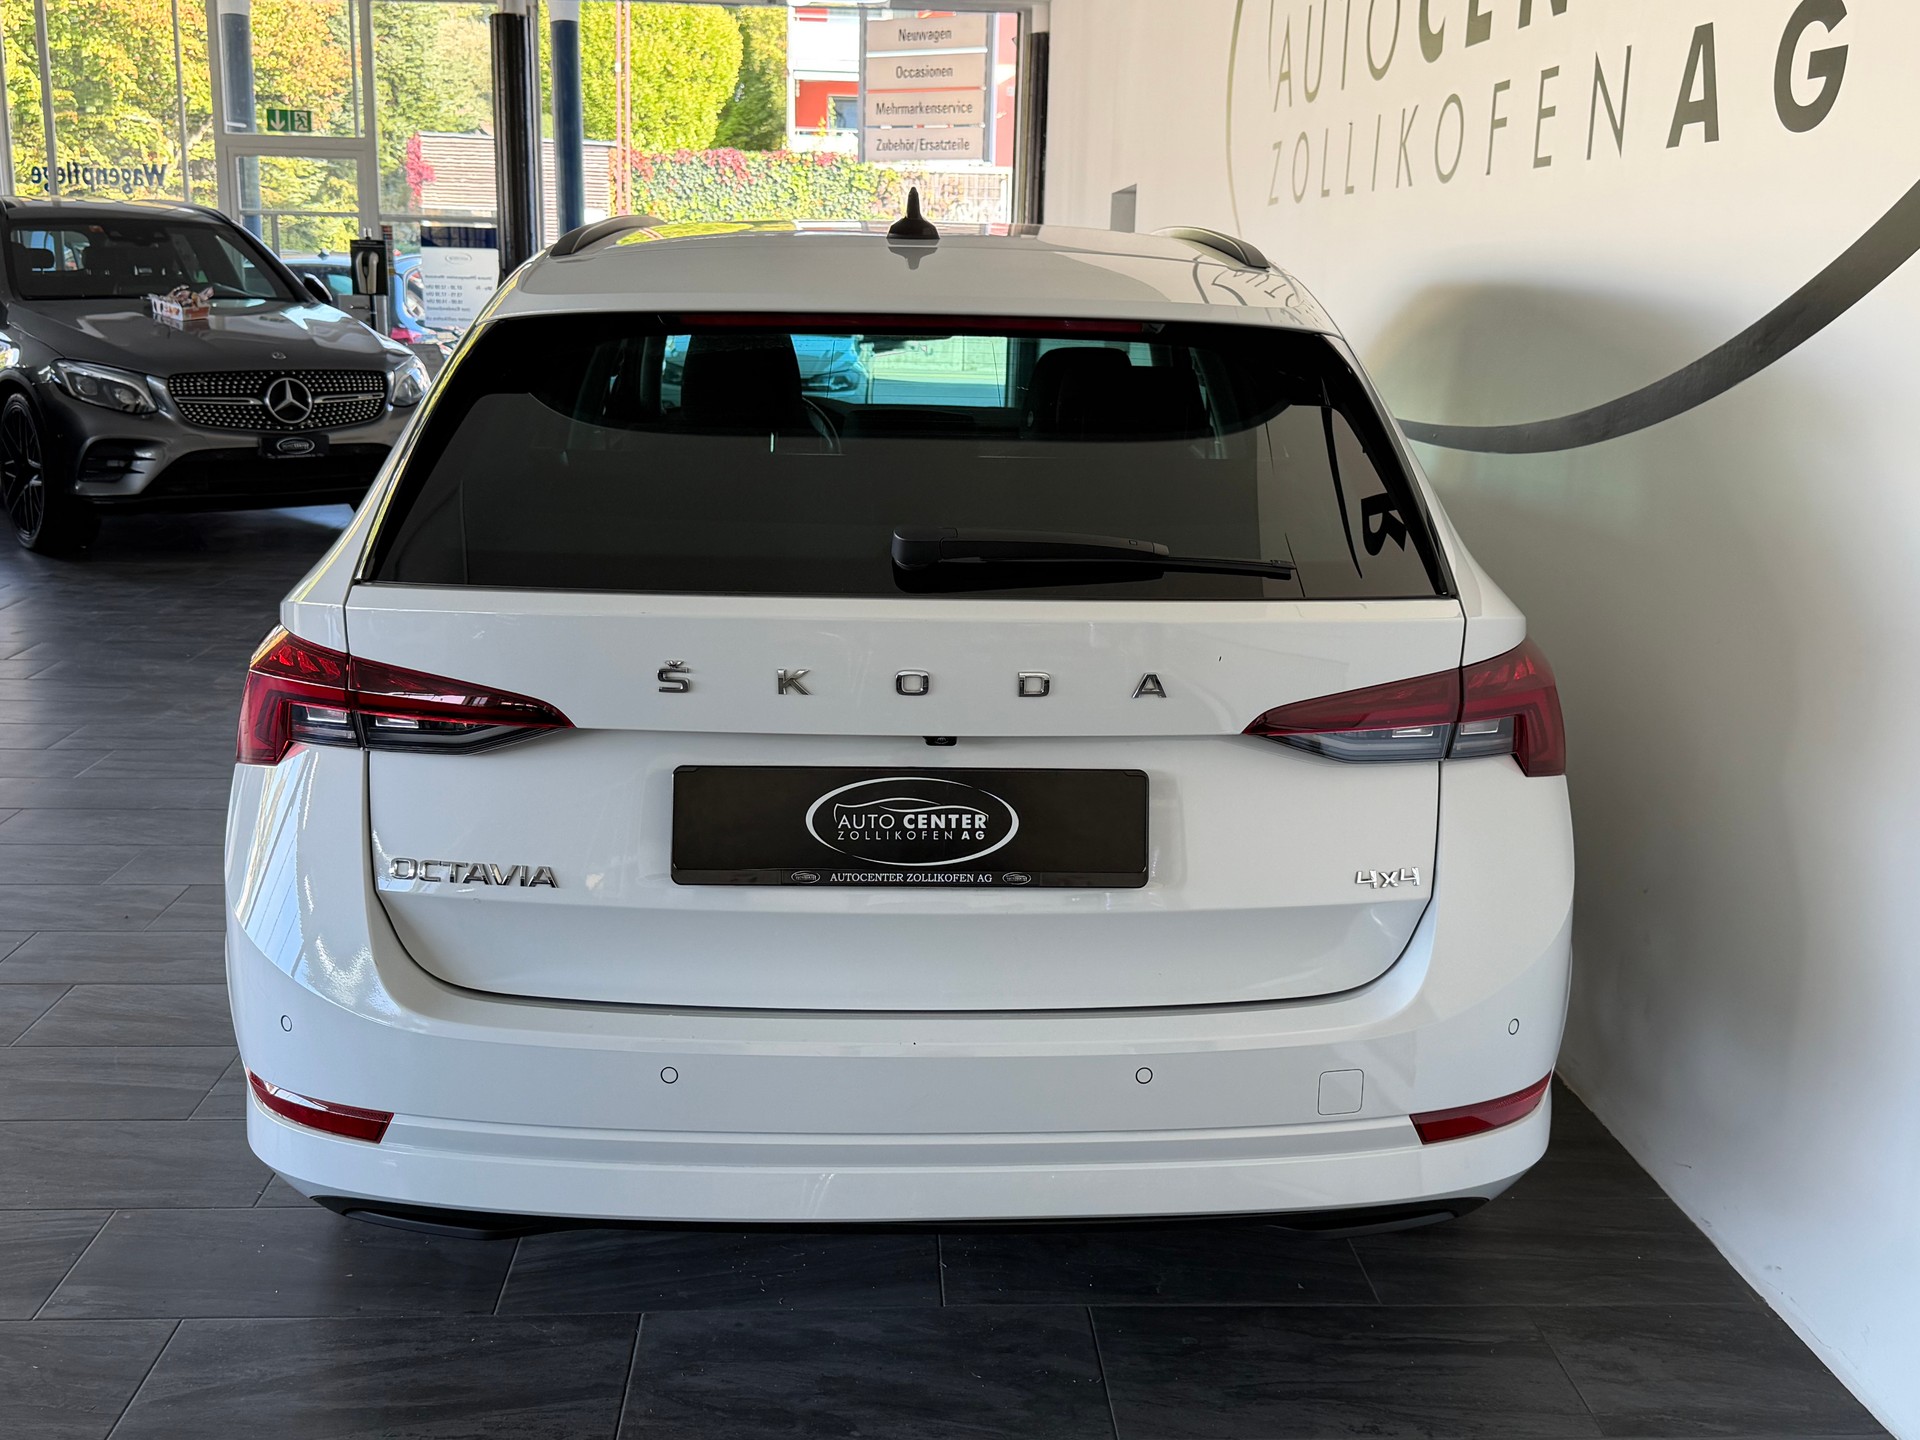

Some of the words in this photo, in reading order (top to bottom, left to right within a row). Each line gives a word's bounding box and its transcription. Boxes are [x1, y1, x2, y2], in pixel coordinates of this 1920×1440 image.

[898, 28, 952, 43] Neuwagen
[1273, 0, 1400, 112] AUTO
[895, 65, 953, 79] Occasionen
[876, 101, 973, 115] Mehrmarkenservice
[1267, 44, 1633, 207] ZOLLIKOFEN
[1666, 0, 1849, 148] AG
[876, 137, 970, 152] Zubehör/Ersatzteile
[657, 660, 1168, 698] ŠKODA
[838, 814, 895, 829] AUTO
[903, 814, 987, 829] CENTER
[837, 830, 953, 840] ZOLLIKOFEN
[961, 830, 985, 840] AG
[389, 857, 559, 888] OCTAVIA
[830, 873, 904, 882] AUTOCENTER
[906, 873, 976, 882] ZOLLIKOFEN
[977, 874, 992, 883] AG
[1355, 867, 1420, 888] 4x4
